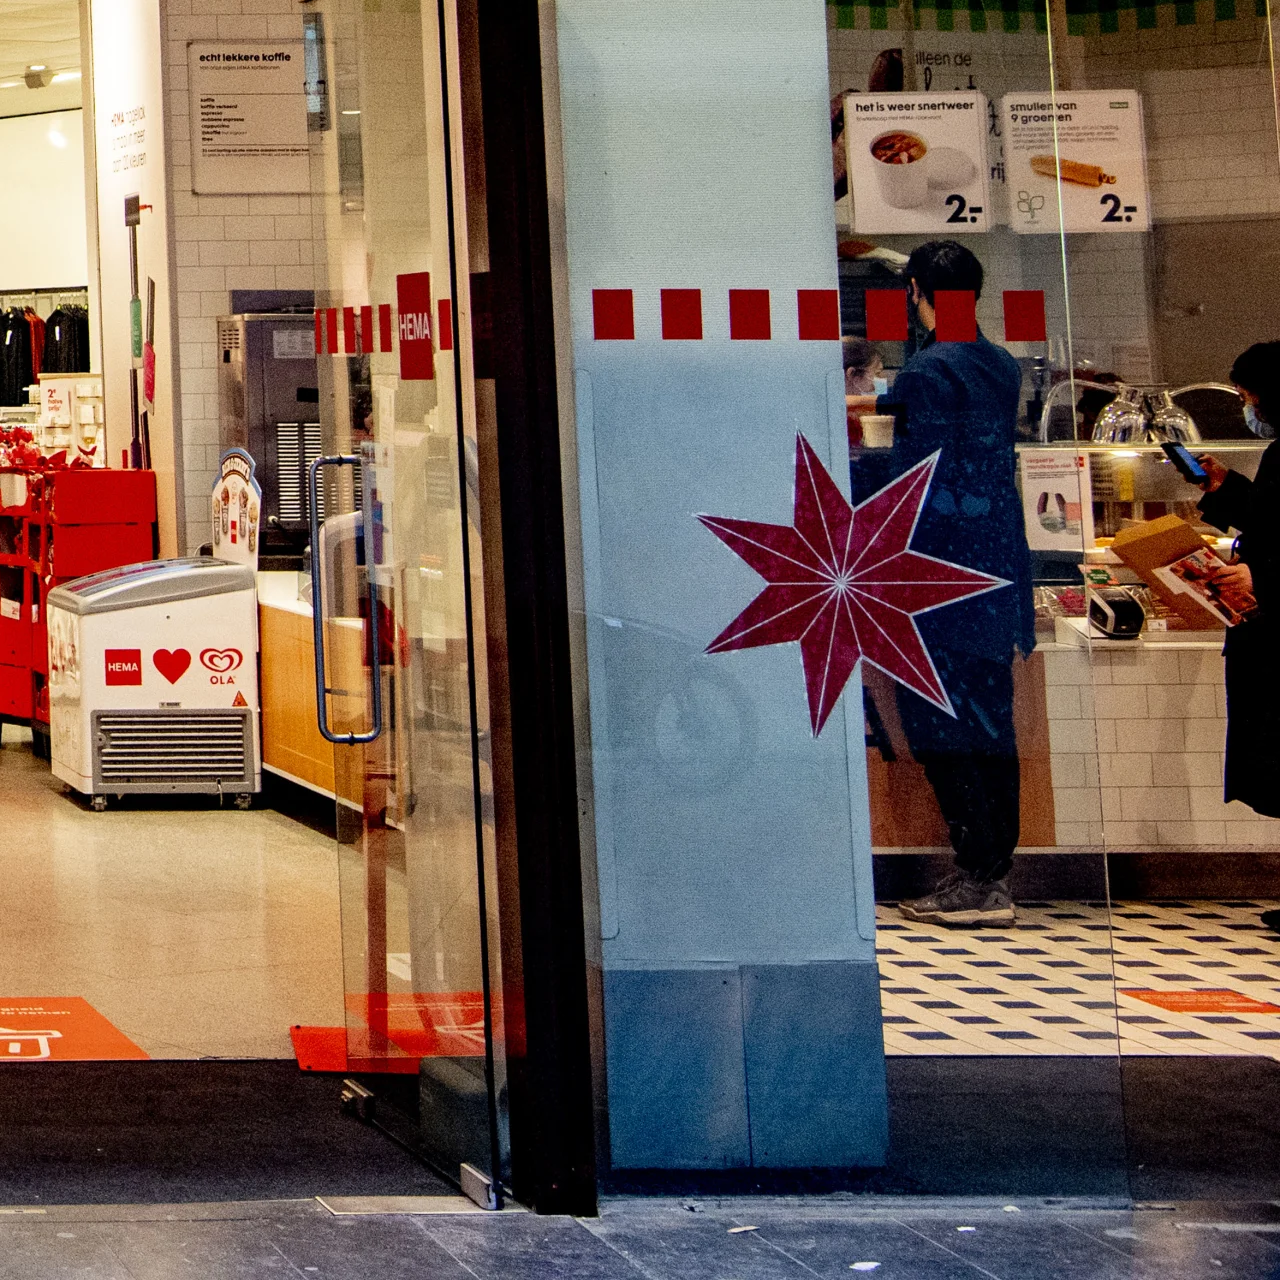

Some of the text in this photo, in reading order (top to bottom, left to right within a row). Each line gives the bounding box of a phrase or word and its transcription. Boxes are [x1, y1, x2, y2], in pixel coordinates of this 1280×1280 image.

[199, 52, 291, 62] echt lekkere koffie
[954, 51, 972, 66] de
[855, 101, 975, 112] het is weer snertweer
[1010, 102, 1077, 111] smullen van
[1011, 114, 1018, 123] 9
[399, 312, 432, 340] HEMA
[107, 663, 139, 672] HEMA
[209, 675, 235, 685] OLA
